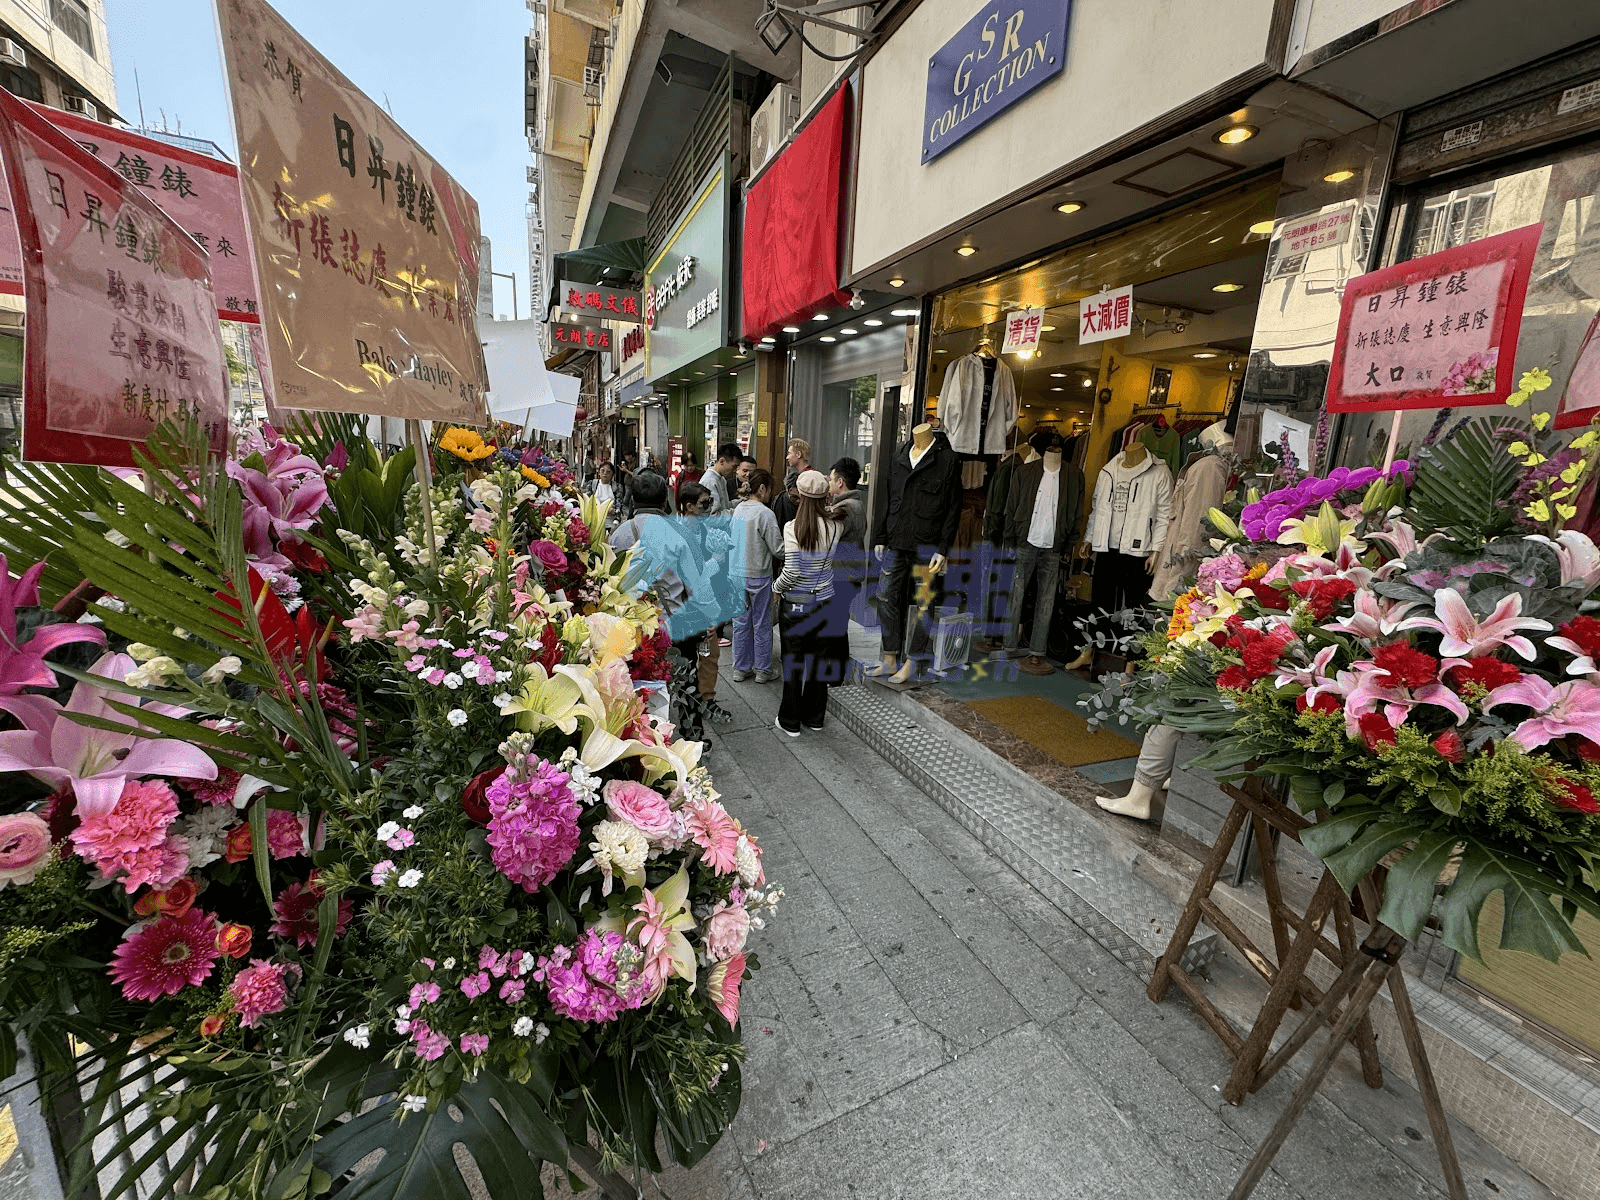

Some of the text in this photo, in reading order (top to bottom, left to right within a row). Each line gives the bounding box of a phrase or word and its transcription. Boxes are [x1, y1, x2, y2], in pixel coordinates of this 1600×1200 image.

[263, 39, 303, 103] 恭賀
[930, 32, 1051, 143] COLLECTION
[566, 288, 639, 318] 數碼文儀
[1082, 294, 1131, 337] 大減價
[108, 317, 192, 381] 生意興隆
[555, 326, 609, 347] 元朗書店
[1006, 315, 1041, 347] 清貨
[1354, 308, 1489, 350] 新張誌慶 生意興隆
[1364, 362, 1405, 388] 大口
